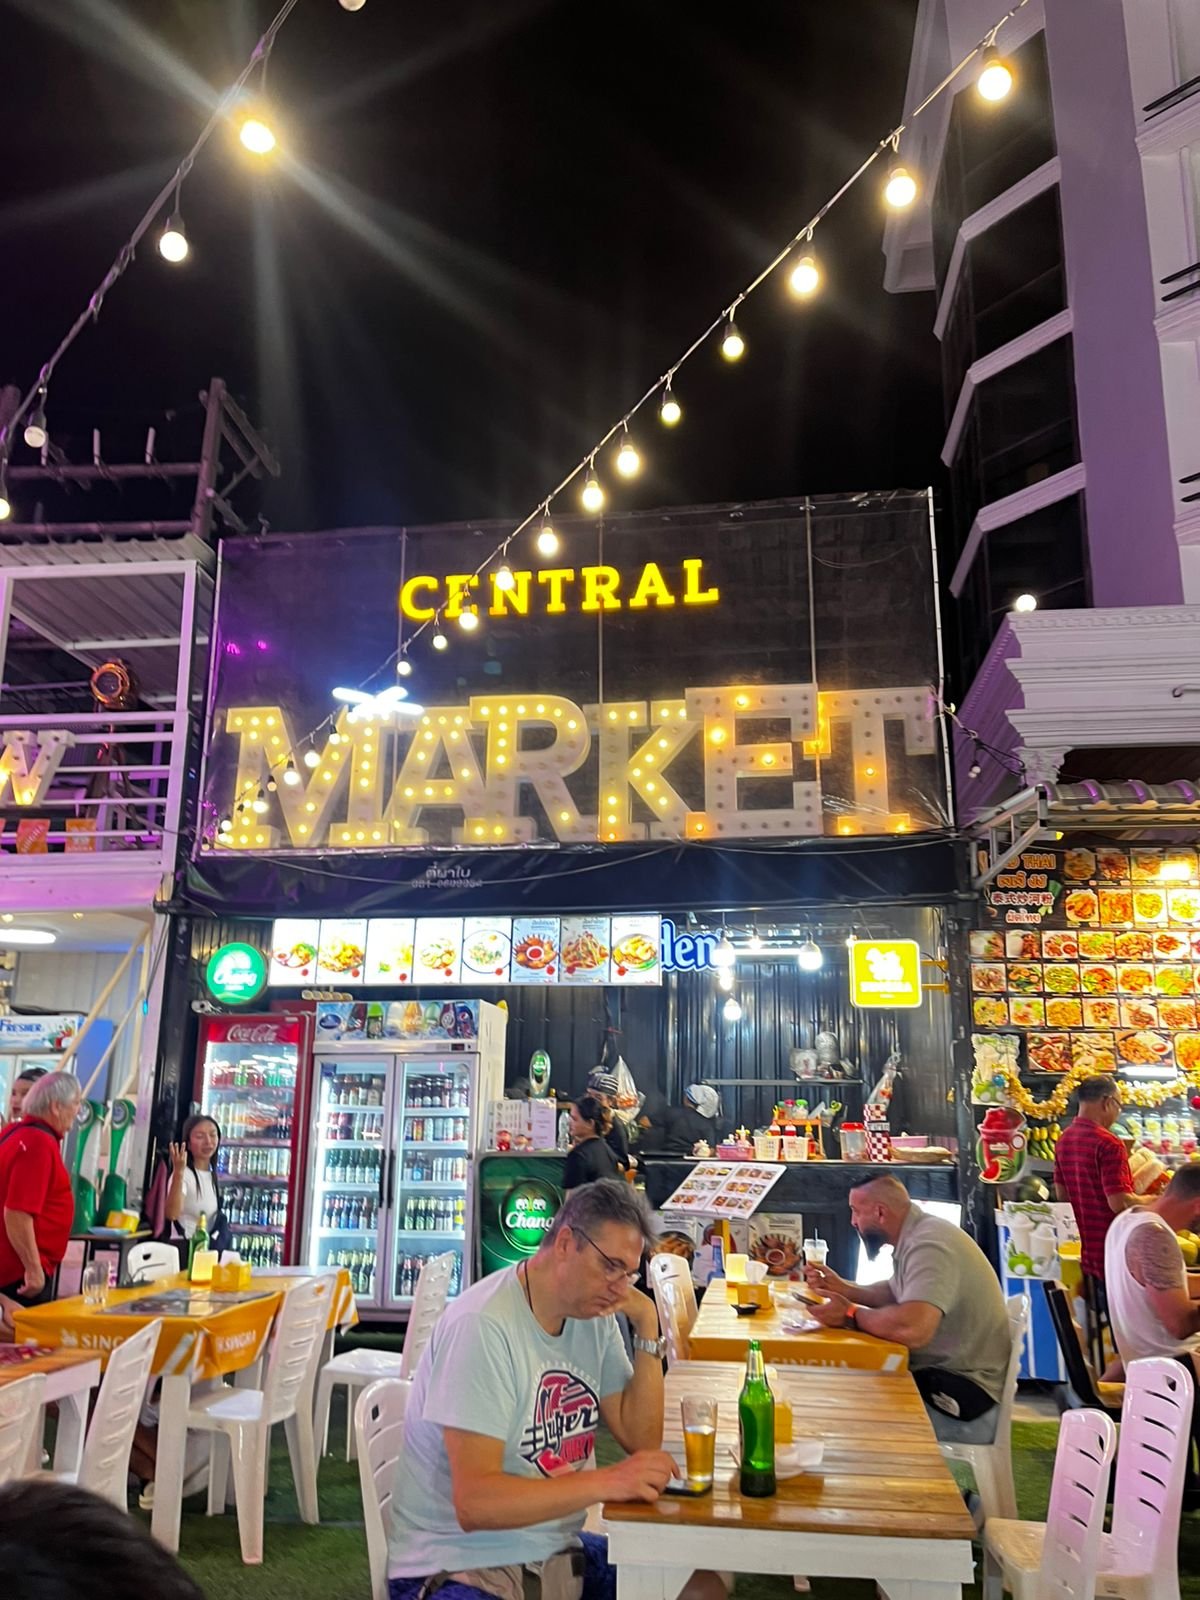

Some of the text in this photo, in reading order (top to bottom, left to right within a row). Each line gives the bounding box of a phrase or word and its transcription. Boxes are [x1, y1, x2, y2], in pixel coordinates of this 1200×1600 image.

[401, 559, 719, 620] CENTRAL
[221, 684, 937, 850] MARKET
[1021, 853, 1056, 869] THAI
[505, 1211, 555, 1232] Chang
[81, 1333, 126, 1350] SING
